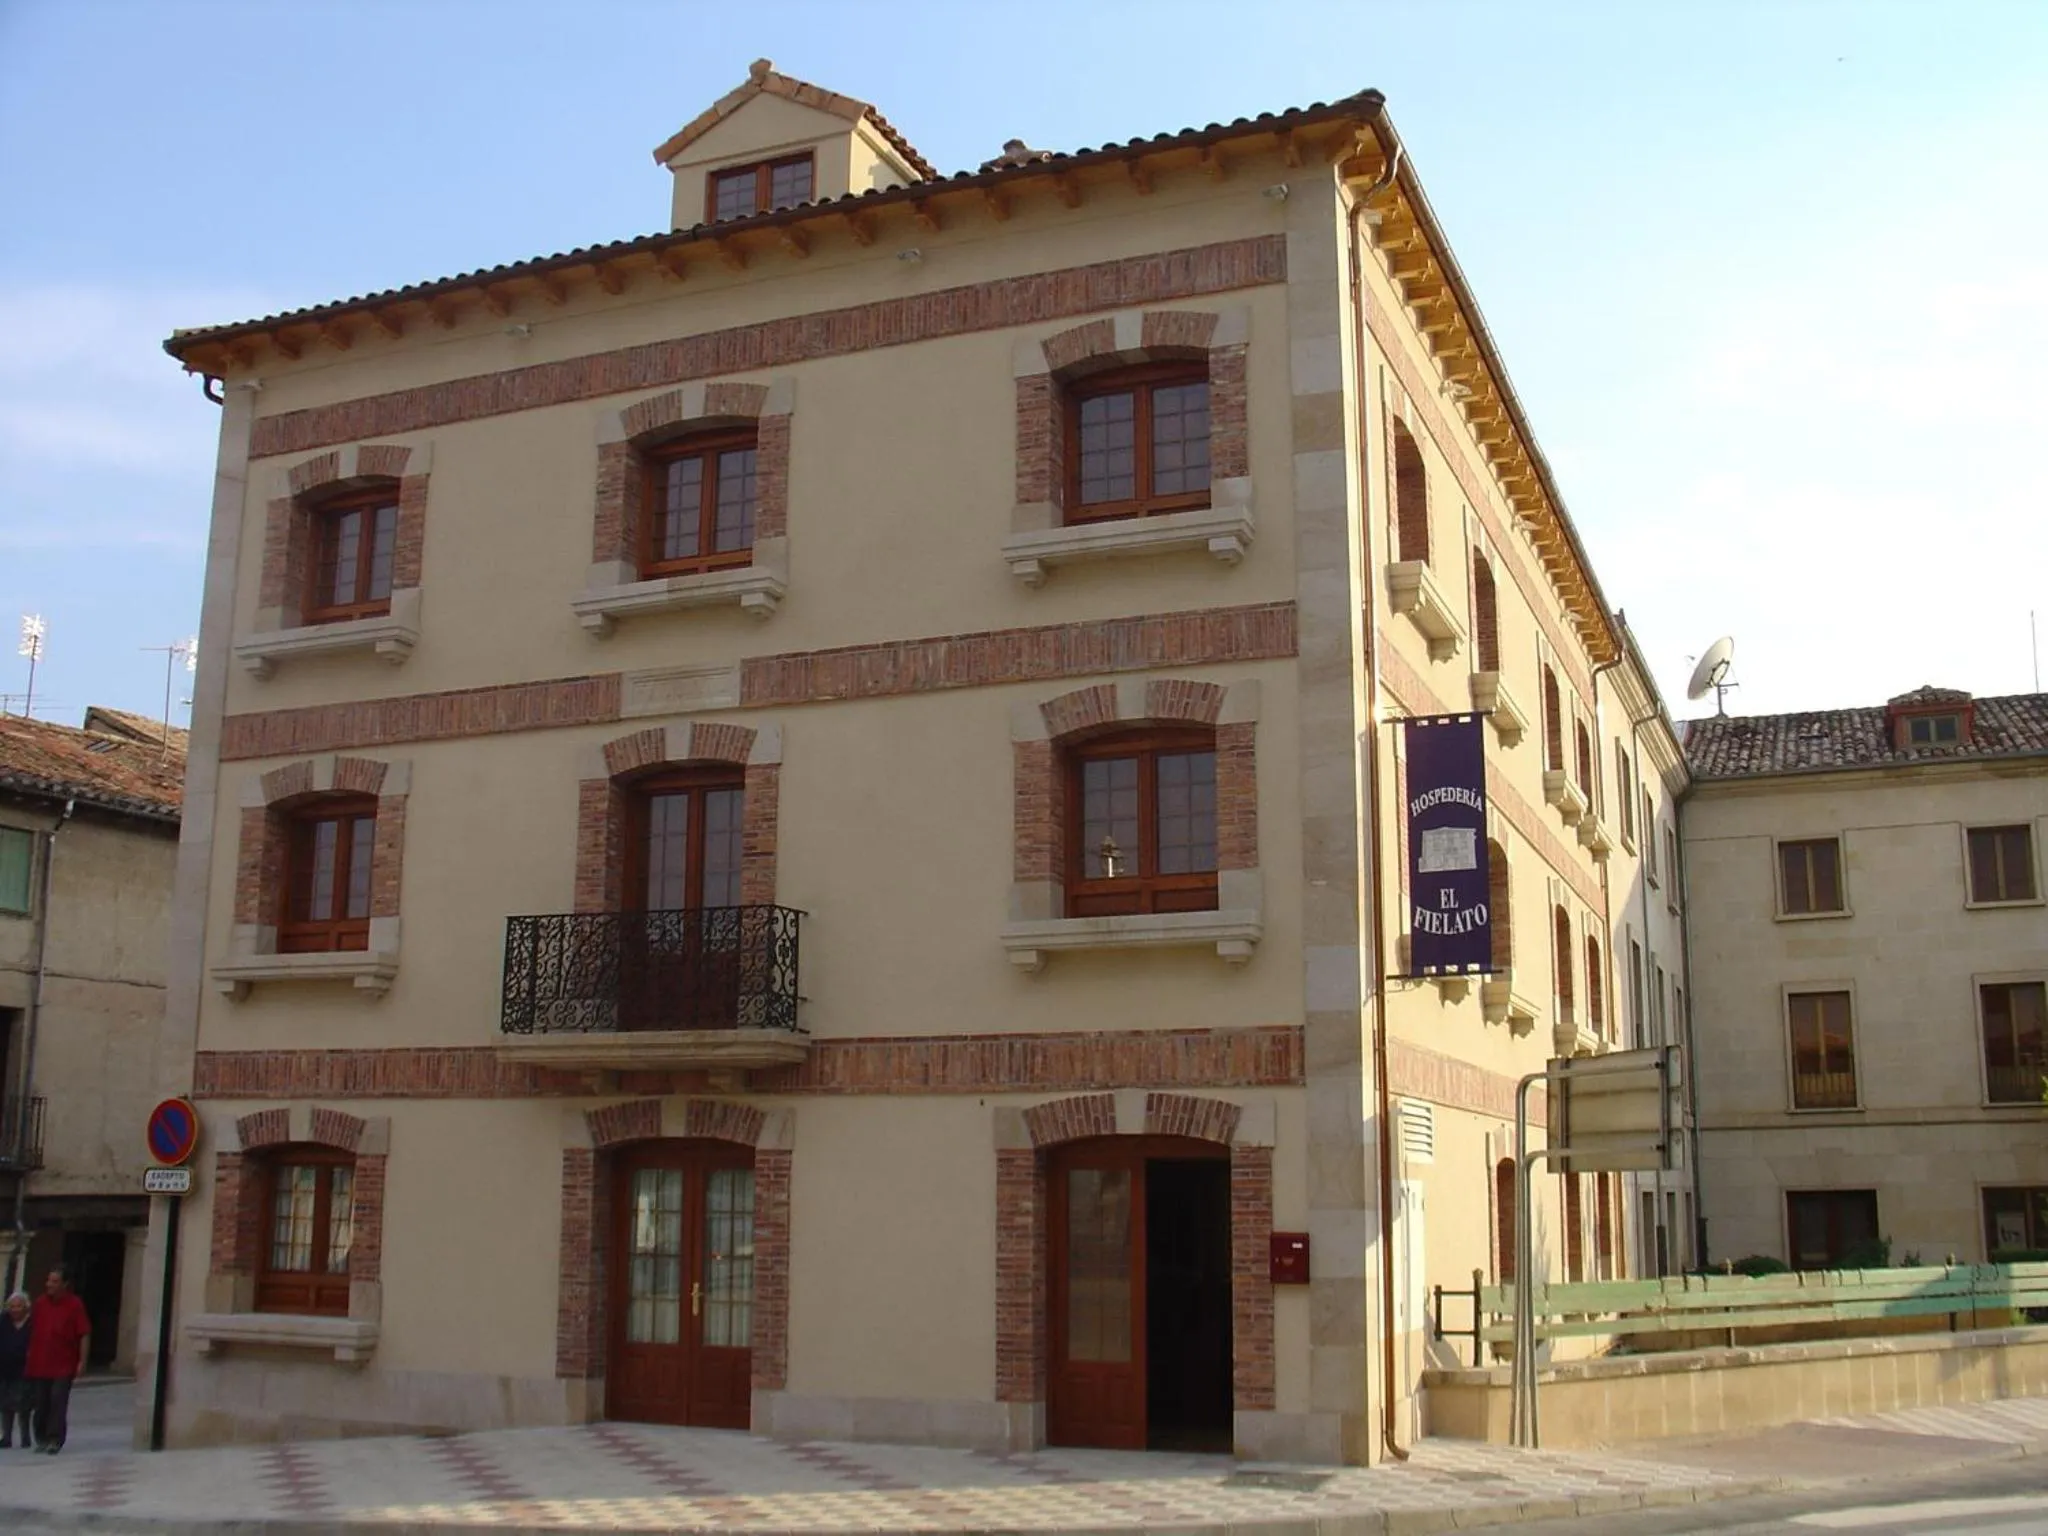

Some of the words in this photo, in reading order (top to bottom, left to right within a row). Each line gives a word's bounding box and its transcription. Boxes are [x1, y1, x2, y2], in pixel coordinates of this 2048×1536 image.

[1411, 787, 1482, 817] HOSPEDERÍA
[1440, 888, 1458, 909] EL
[1414, 903, 1488, 934] FIELATO
